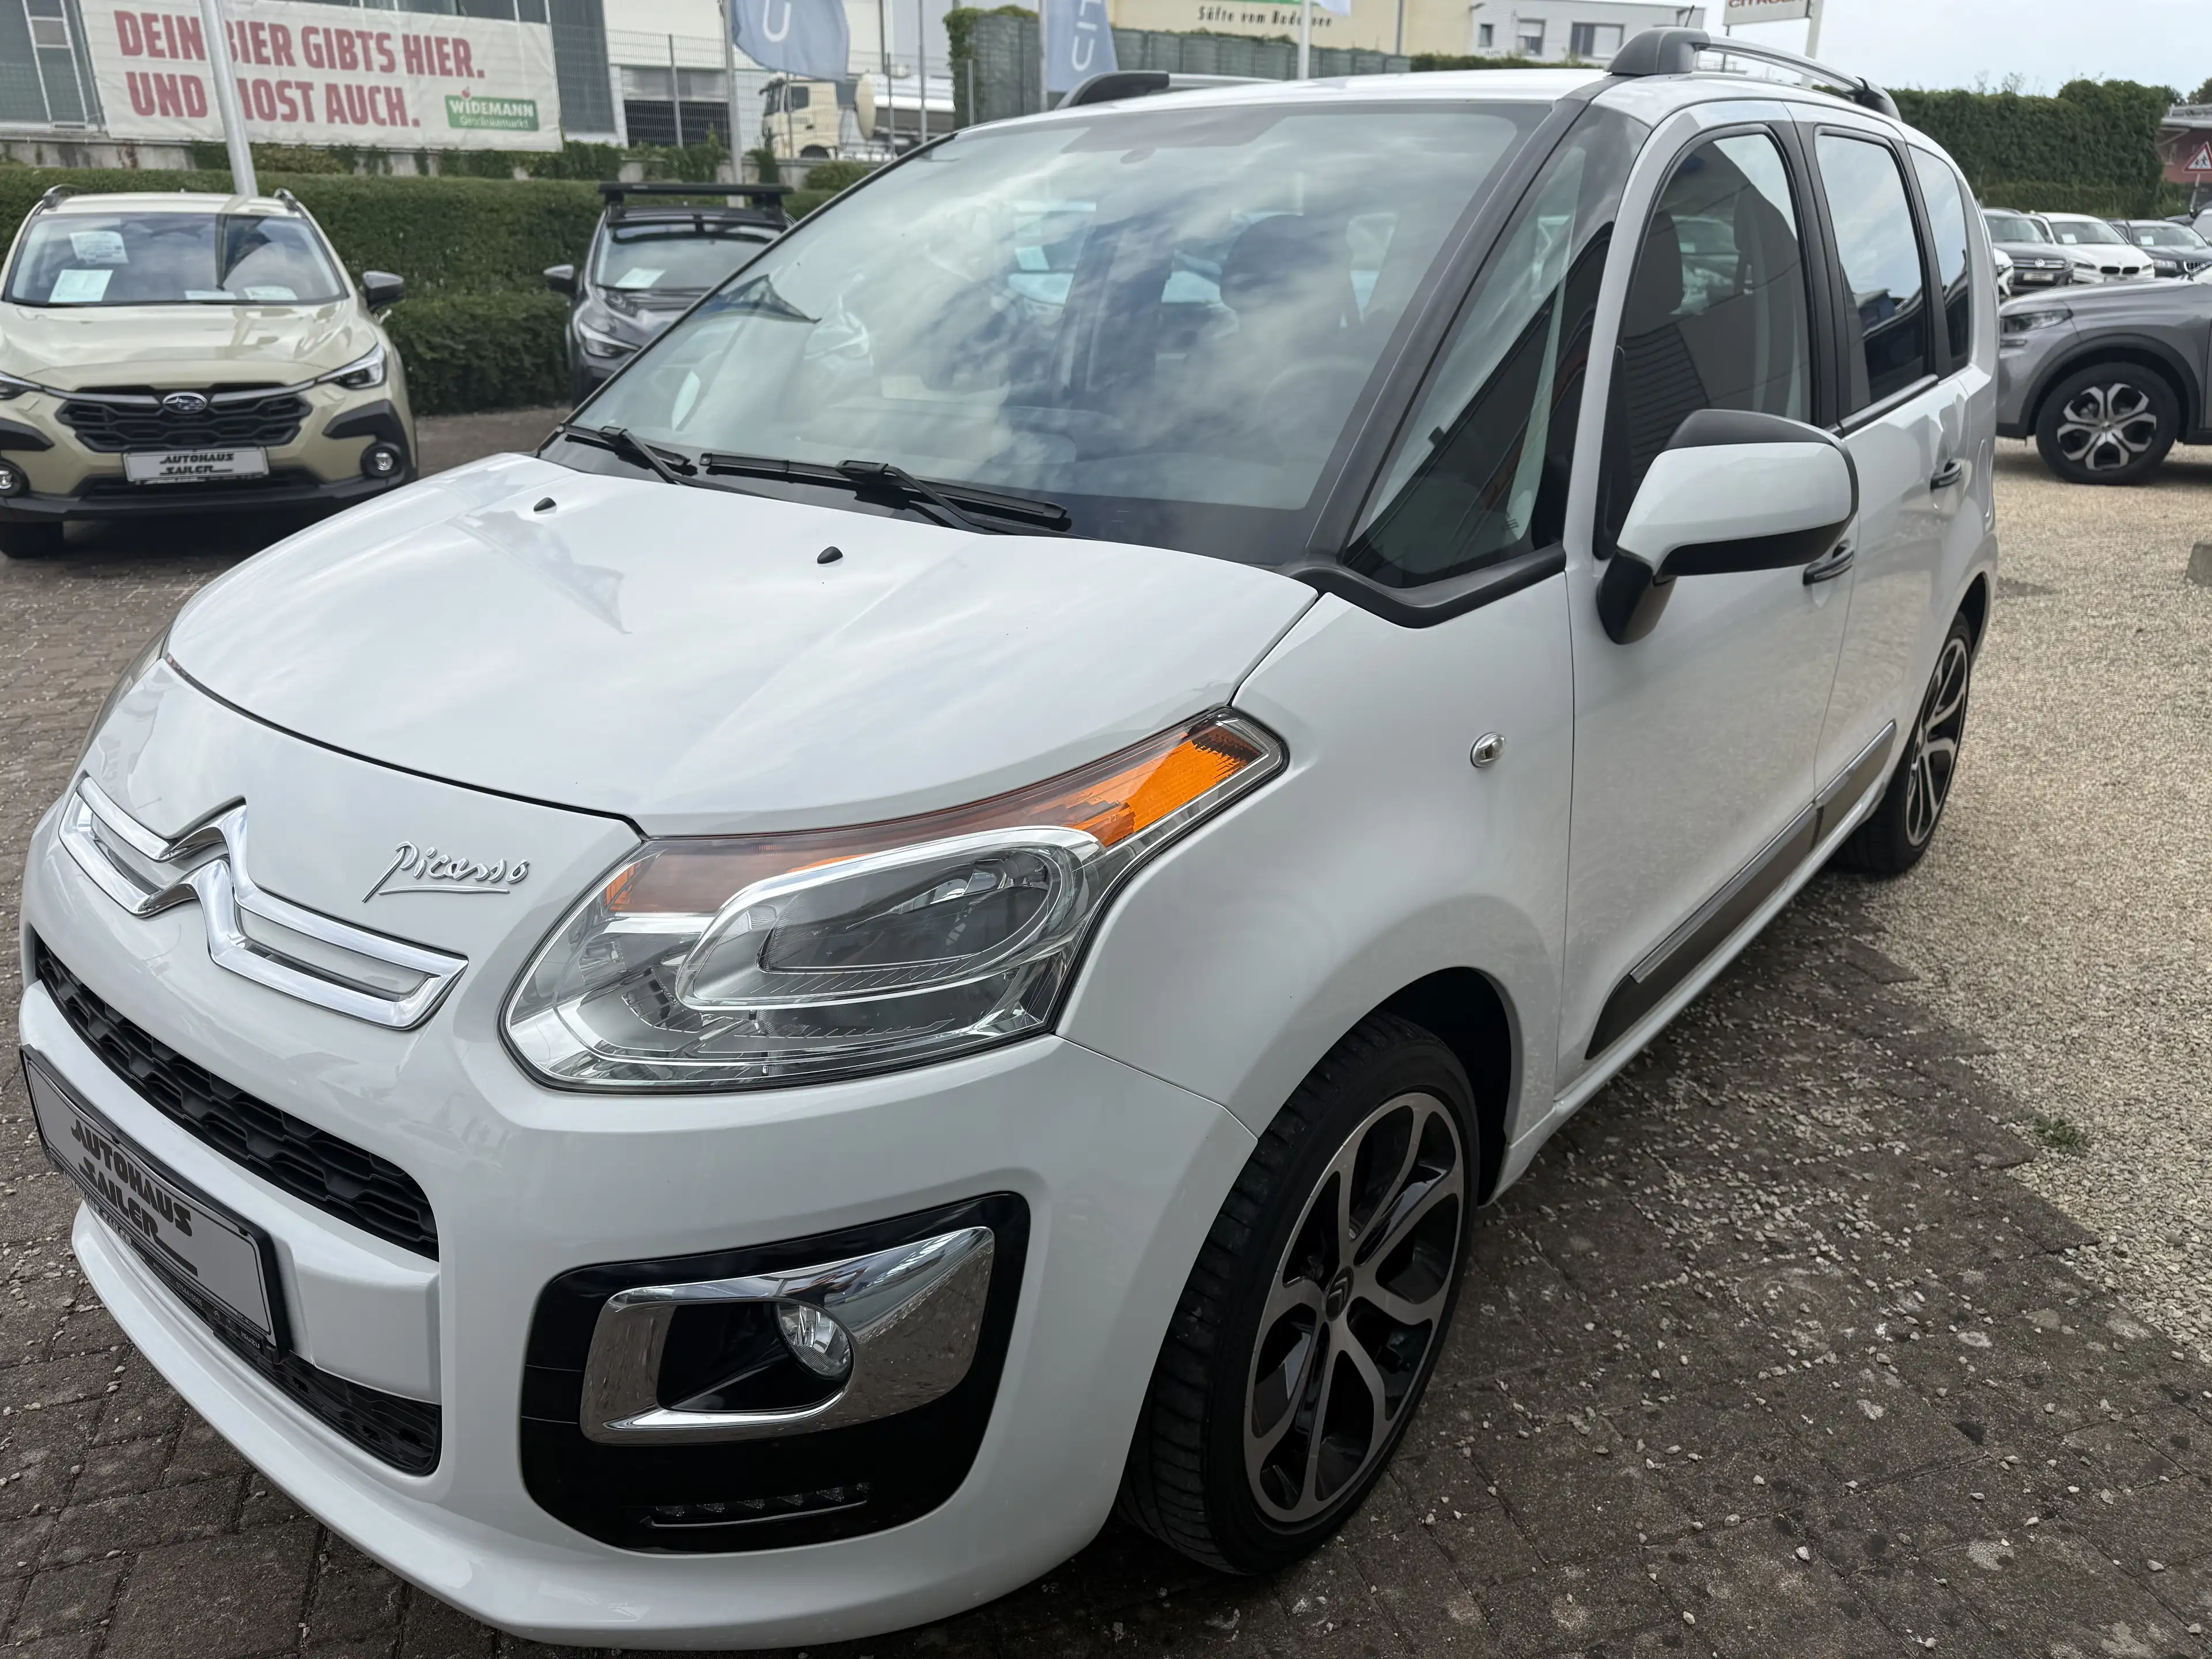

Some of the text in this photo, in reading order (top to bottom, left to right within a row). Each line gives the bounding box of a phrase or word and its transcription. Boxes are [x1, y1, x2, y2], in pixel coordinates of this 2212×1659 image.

[1240, 12, 1266, 25] vom
[113, 10, 206, 61] DEIN
[301, 25, 396, 73] GIBTS
[402, 33, 485, 78] HIER.
[124, 71, 208, 119] UND
[324, 82, 421, 128] AUCH.
[448, 99, 535, 118] WIDEMANN
[160, 453, 234, 464] AUTOHAUS
[160, 465, 233, 476] SAILER
[361, 840, 530, 904] Picasso
[71, 1119, 192, 1237] AUTOHAUS
[240, 1330, 261, 1349] ISUZU
